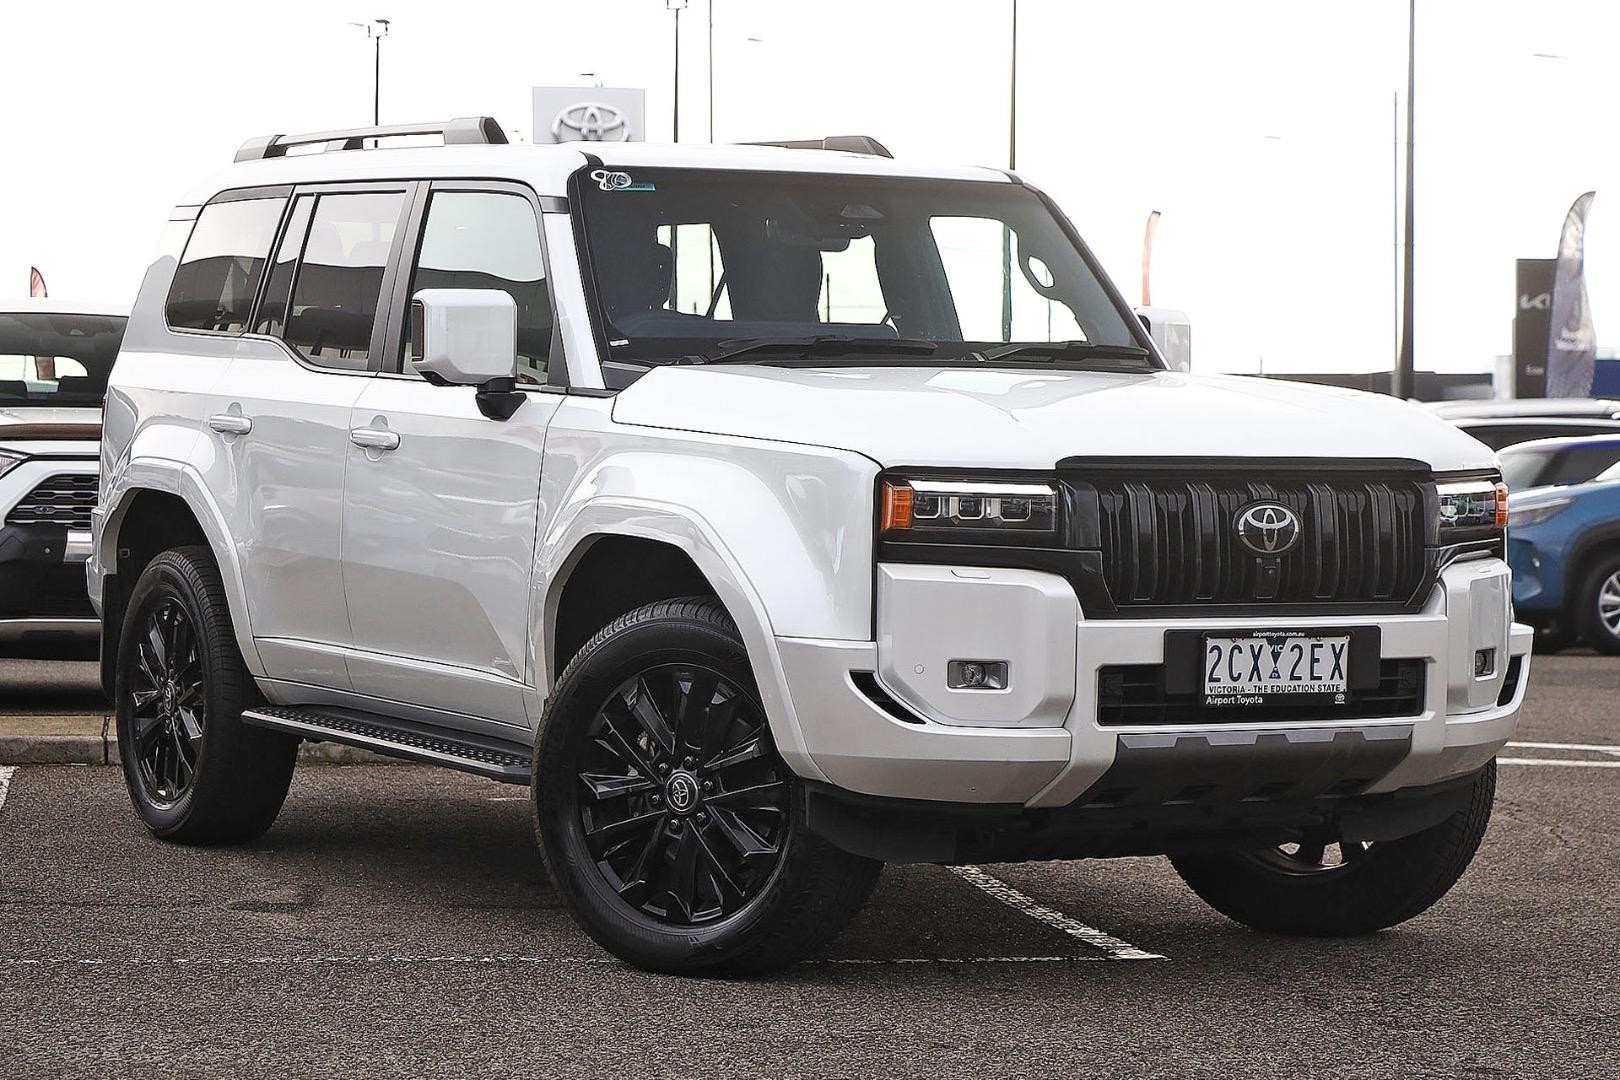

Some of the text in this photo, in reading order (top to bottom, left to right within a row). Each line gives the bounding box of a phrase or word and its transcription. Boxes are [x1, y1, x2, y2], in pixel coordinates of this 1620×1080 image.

[1208, 643, 1346, 683] 2CX 2EX
[1208, 685, 1245, 694] VICTORIA
[1252, 684, 1269, 693] THE
[1270, 684, 1315, 693] EDUCATION
[1317, 684, 1341, 692] STATE
[1205, 695, 1264, 707] Airport Toyota
